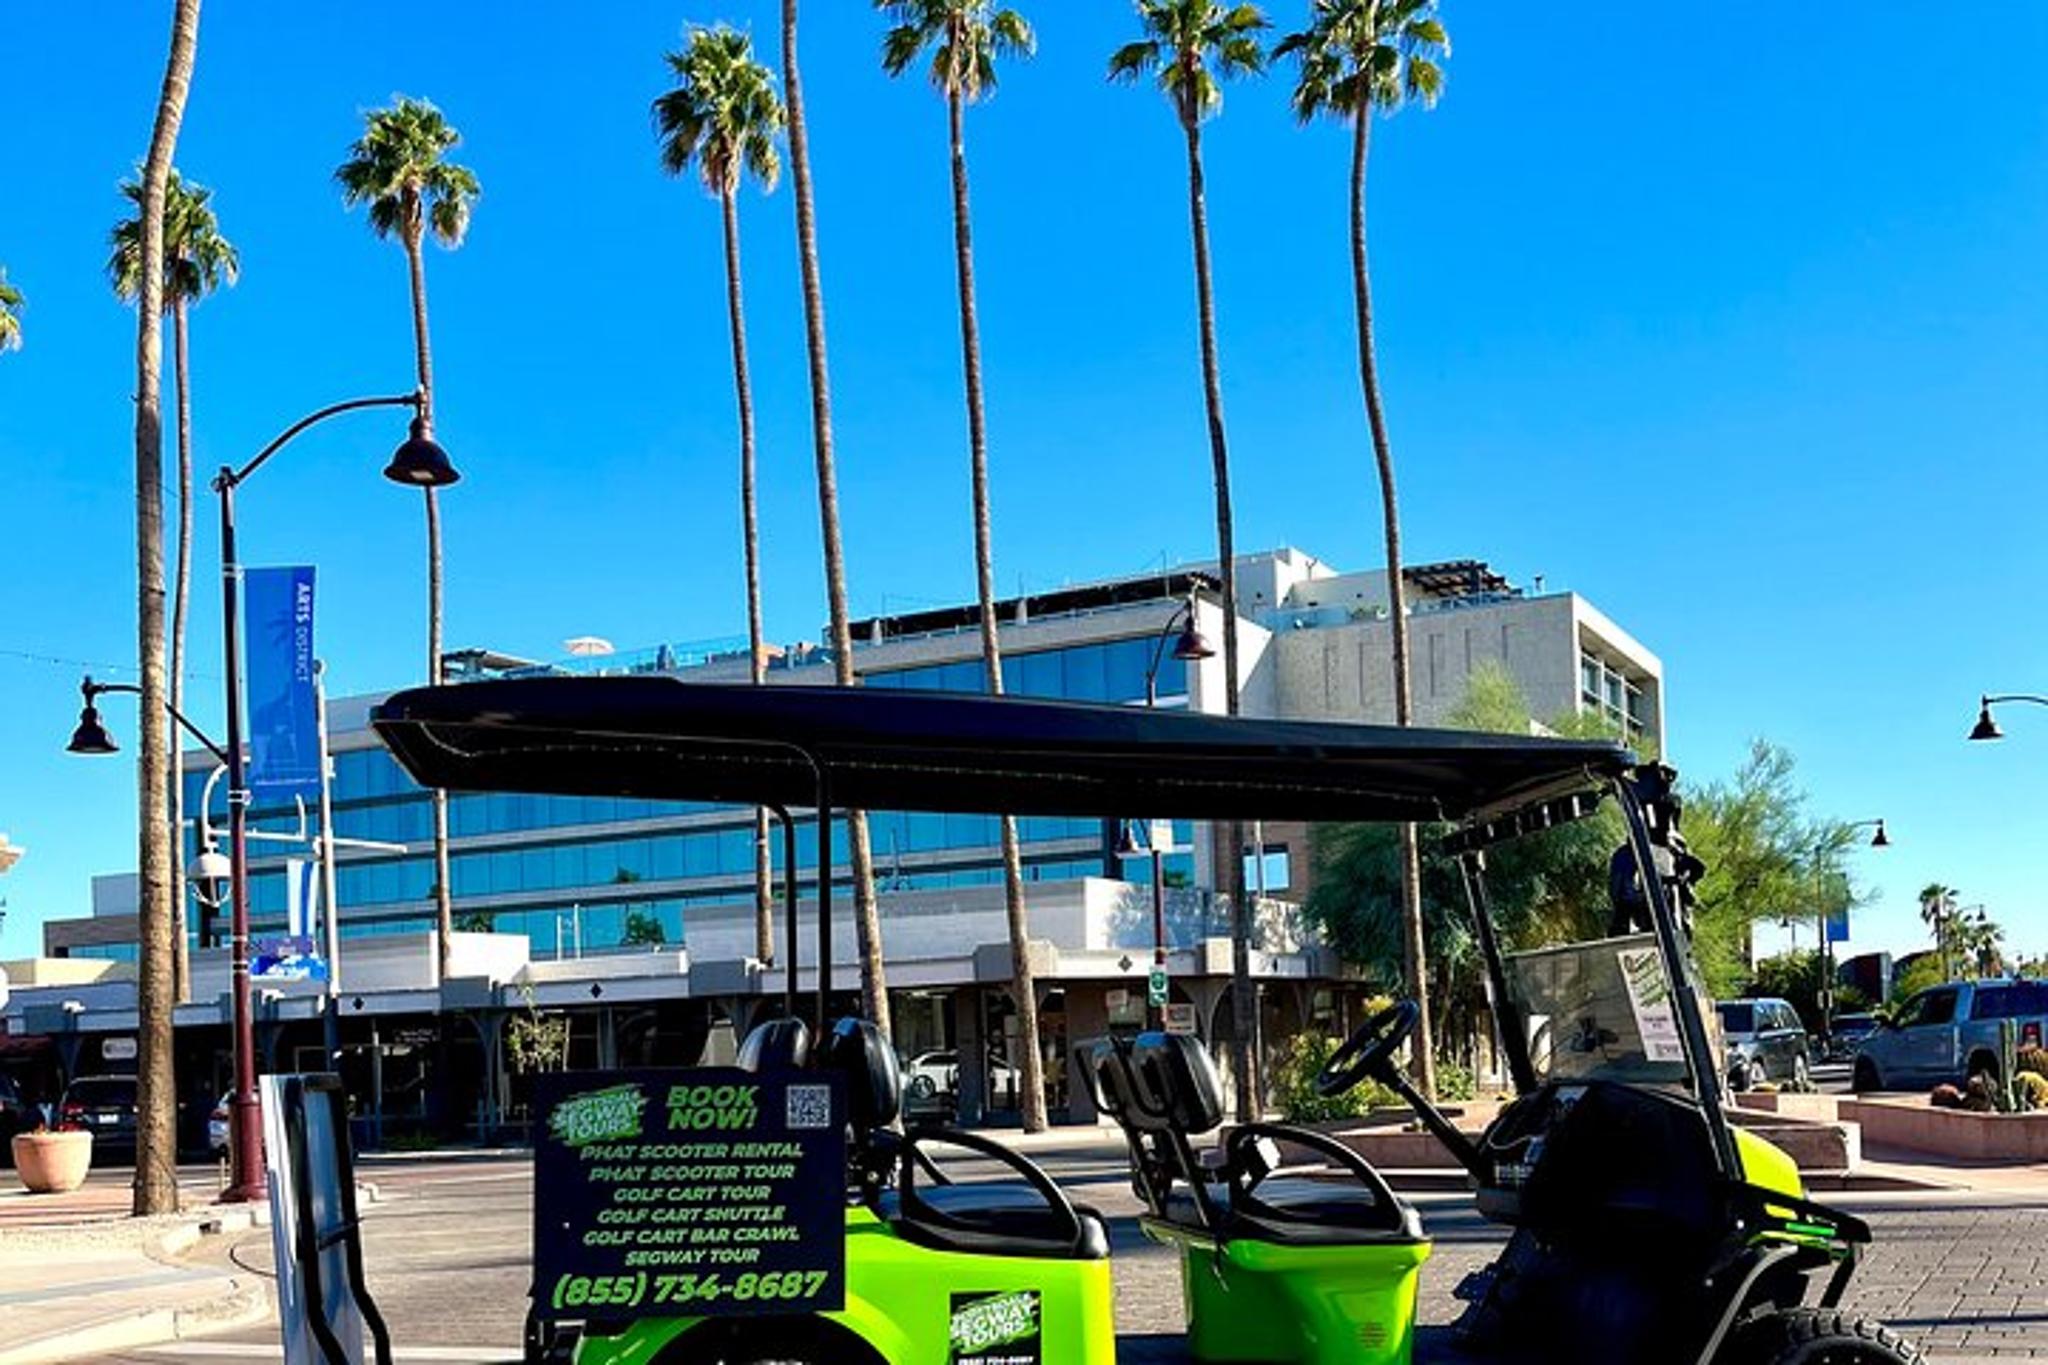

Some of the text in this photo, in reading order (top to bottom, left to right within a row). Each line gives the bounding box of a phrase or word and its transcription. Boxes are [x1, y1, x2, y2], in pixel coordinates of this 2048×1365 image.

[296, 582, 311, 623] ARTS
[665, 1085, 760, 1107] BOOK
[667, 1107, 758, 1130] NOW!
[580, 1142, 804, 1161] PHAT SCOOTER RENTAL
[588, 1163, 796, 1182] PHAT SCOOTER TOUR
[613, 1184, 772, 1202] GOLF CART TOUR
[596, 1205, 786, 1225] GOLF CART SHUTTLE
[582, 1226, 801, 1246] GOLF CART BAR CRAWL
[624, 1247, 761, 1267] SEGWAY TOUR
[552, 1270, 829, 1309] (855) 734-8687
